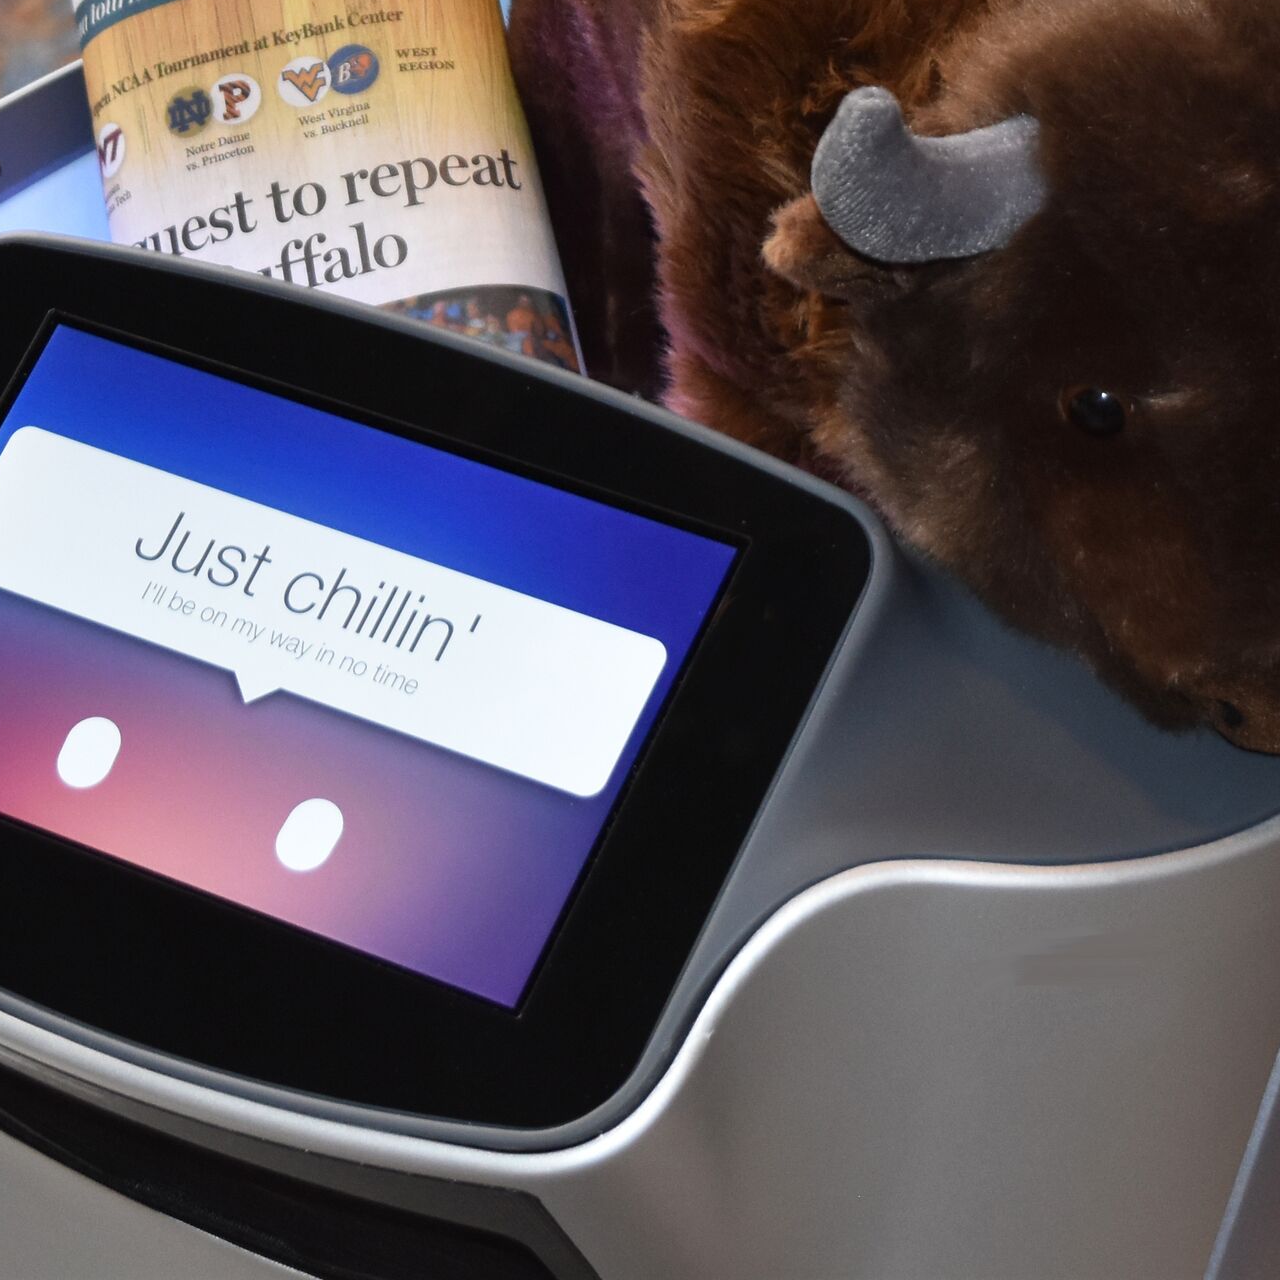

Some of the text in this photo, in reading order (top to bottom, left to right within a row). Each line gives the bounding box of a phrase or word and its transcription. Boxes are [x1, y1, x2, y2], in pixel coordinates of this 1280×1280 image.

[111, 67, 153, 100] NCAA
[154, 37, 251, 80] Tournament
[253, 34, 269, 52] at
[272, 14, 345, 46] KeyBank
[346, 8, 404, 28] Center
[396, 47, 438, 59] WEST
[399, 60, 456, 72] REGION
[298, 113, 326, 127] West
[303, 114, 369, 139] vs. Bucknell
[185, 132, 250, 158] Notre Dame
[186, 145, 255, 172] vs. Princeton
[266, 180, 327, 223] to
[340, 148, 521, 208] repeat
[134, 511, 482, 662] Just chillin'
[141, 581, 419, 695] I'll be on my way in no time
